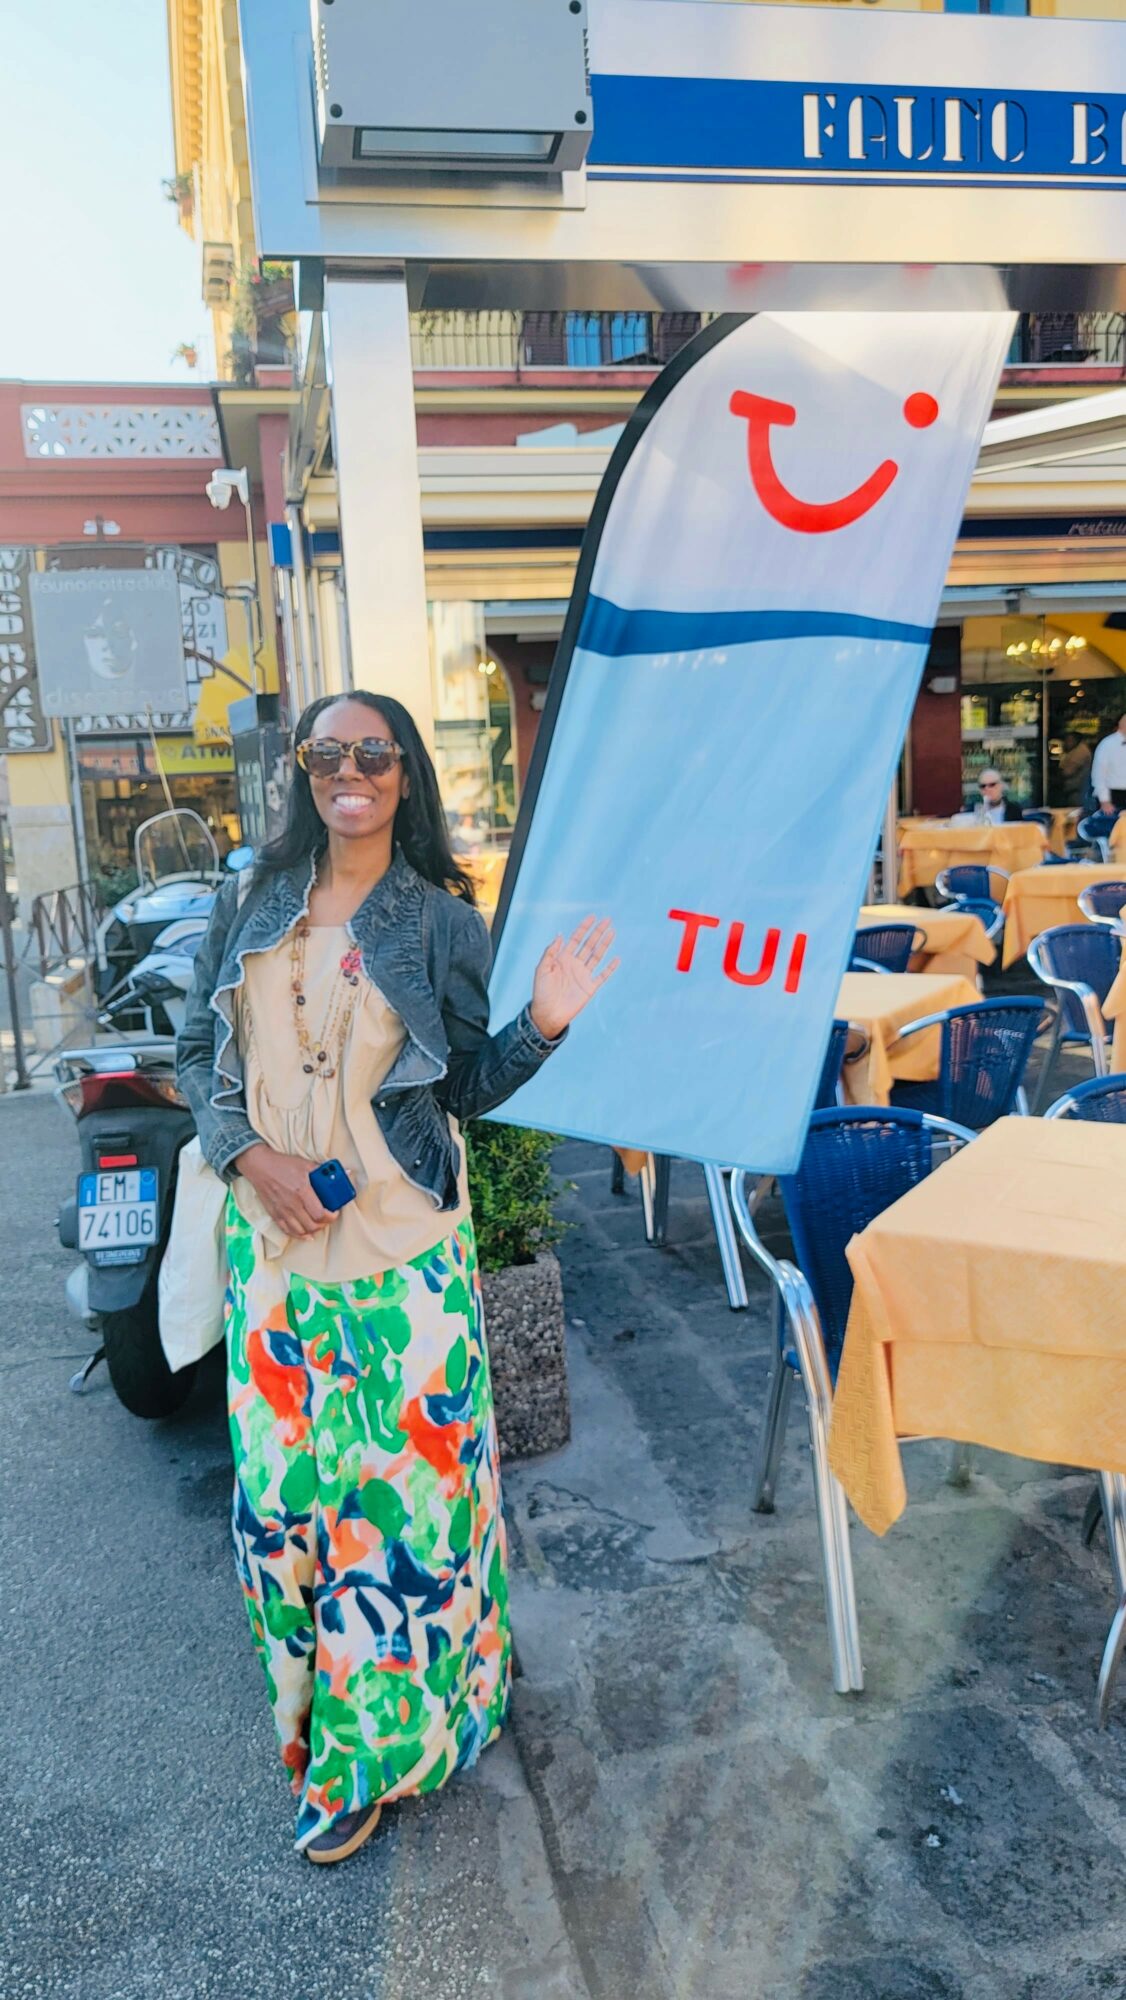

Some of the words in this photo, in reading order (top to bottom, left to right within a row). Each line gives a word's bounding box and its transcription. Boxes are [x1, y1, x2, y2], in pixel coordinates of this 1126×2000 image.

[803, 93, 1028, 163] FAUNO
[1070, 102, 1126, 166] B
[181, 743, 232, 759] ATM
[668, 909, 808, 993] TUI
[100, 1174, 126, 1201] EM
[84, 1209, 153, 1241] 74106
